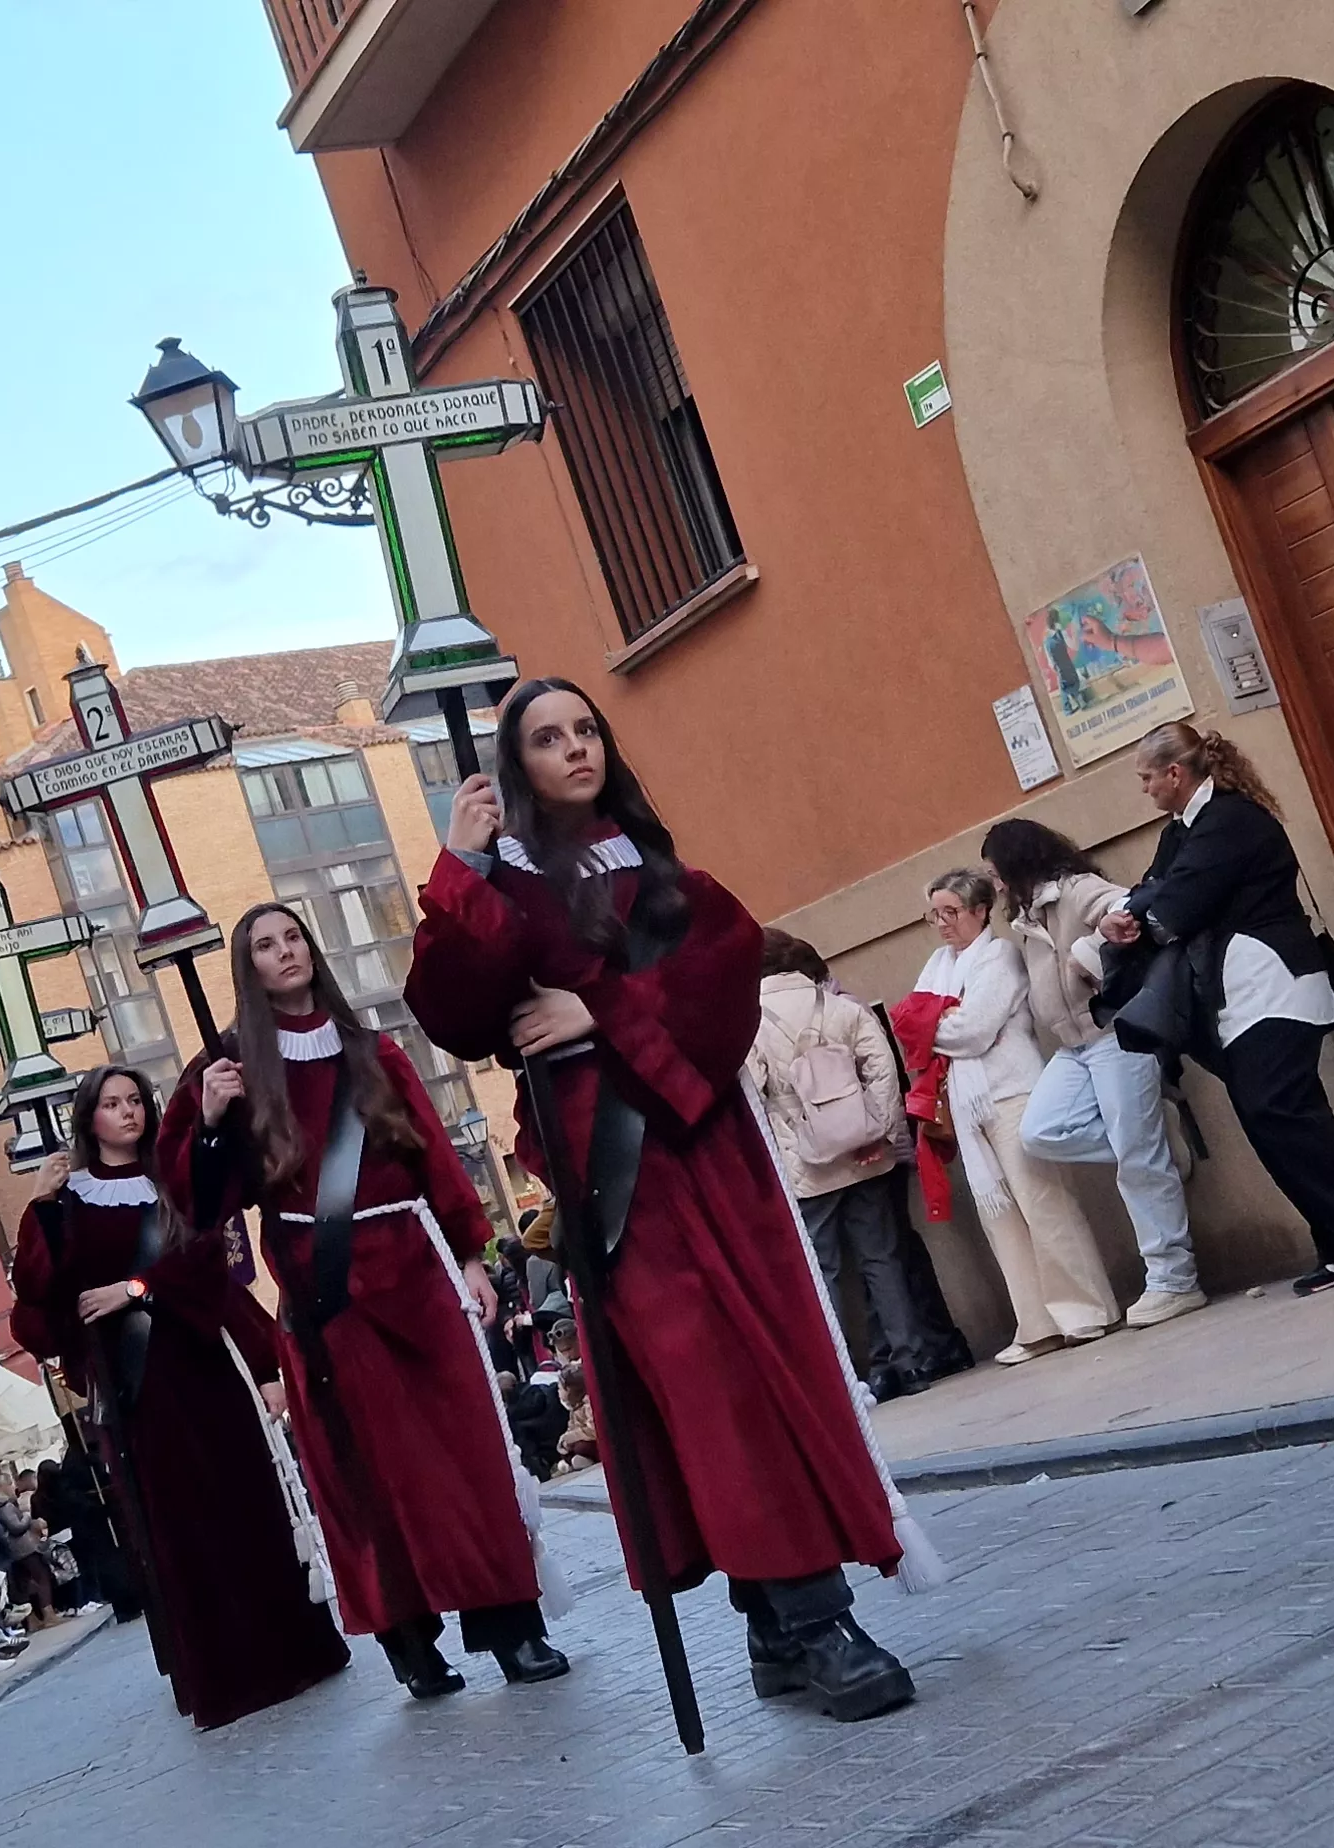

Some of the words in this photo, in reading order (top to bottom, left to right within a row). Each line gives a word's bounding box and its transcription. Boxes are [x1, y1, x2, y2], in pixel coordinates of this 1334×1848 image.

[349, 402, 439, 424] PERDONALES
[443, 389, 498, 411] PORQUE
[308, 432, 329, 447] NO
[332, 425, 377, 445] SABEN
[383, 421, 399, 438] LO
[403, 416, 431, 433] QUE
[36, 770, 51, 784] TE
[54, 763, 82, 777] DIGO
[85, 755, 108, 768] QUE
[138, 730, 190, 755] ESTARAS
[45, 772, 97, 794] CONMIGO
[102, 766, 118, 778] EN
[121, 761, 135, 773] EL
